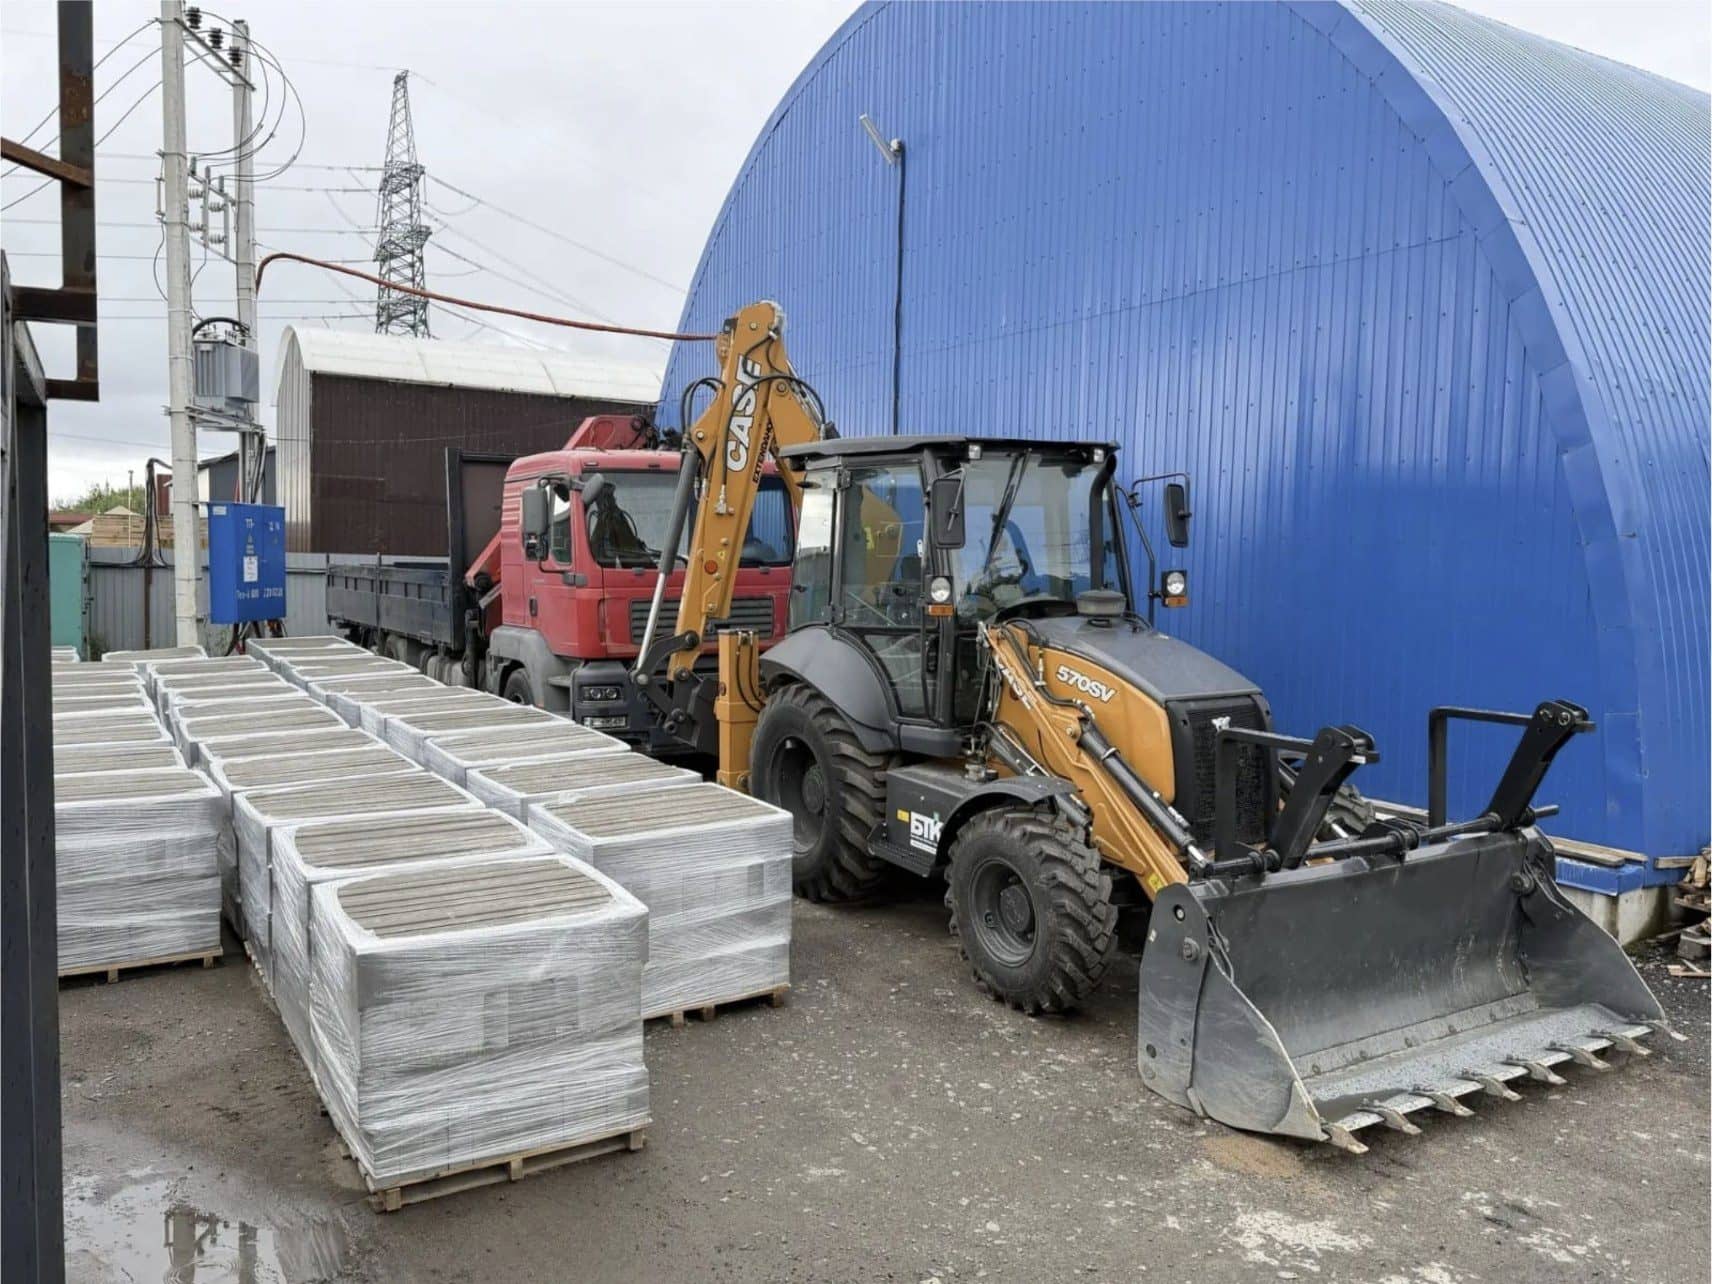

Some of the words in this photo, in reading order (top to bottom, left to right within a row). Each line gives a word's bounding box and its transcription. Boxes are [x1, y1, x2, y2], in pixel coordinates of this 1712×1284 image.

[727, 354, 761, 471] CASE
[752, 418, 774, 483] EXTENDAHO
[1056, 664, 1117, 702] 570SV
